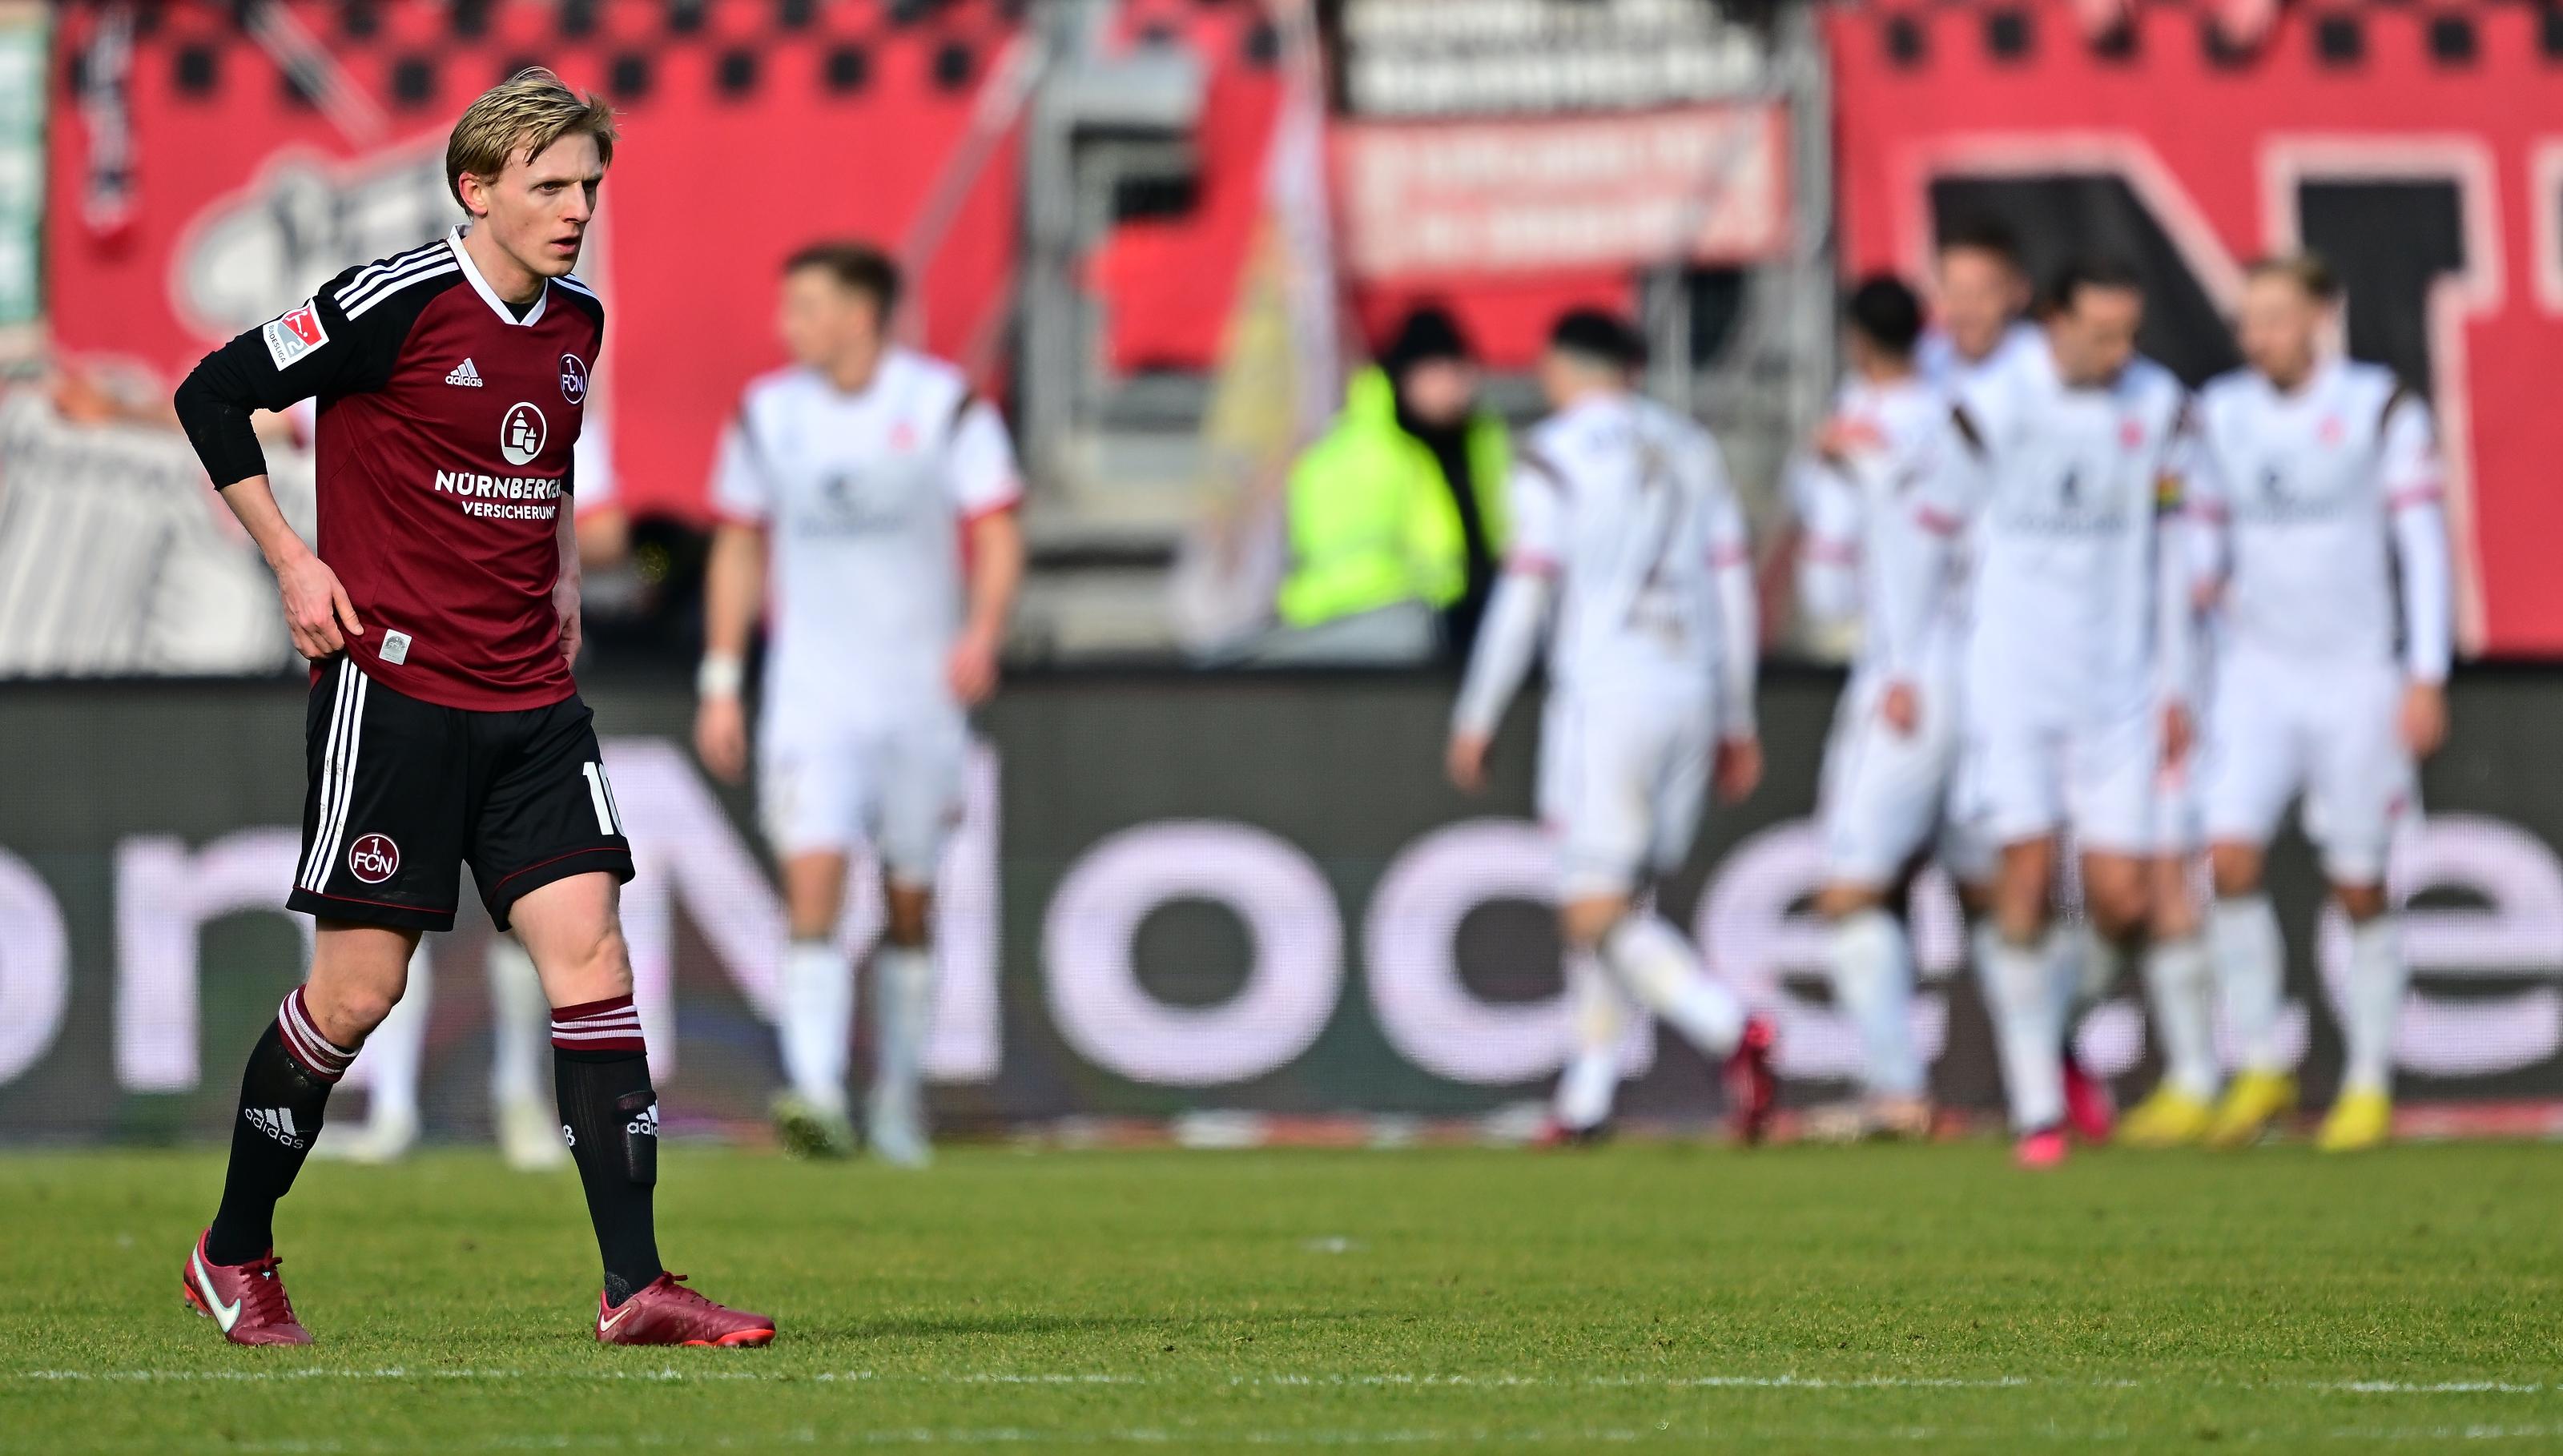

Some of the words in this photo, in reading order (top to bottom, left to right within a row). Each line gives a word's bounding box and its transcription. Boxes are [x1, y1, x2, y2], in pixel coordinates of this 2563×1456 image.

[445, 374, 483, 388] adidas
[561, 374, 584, 392] FCN
[462, 501, 556, 520] VERSICHERUN
[371, 838, 381, 855] 1.
[353, 851, 393, 875] FCN
[245, 1108, 304, 1149] adidas
